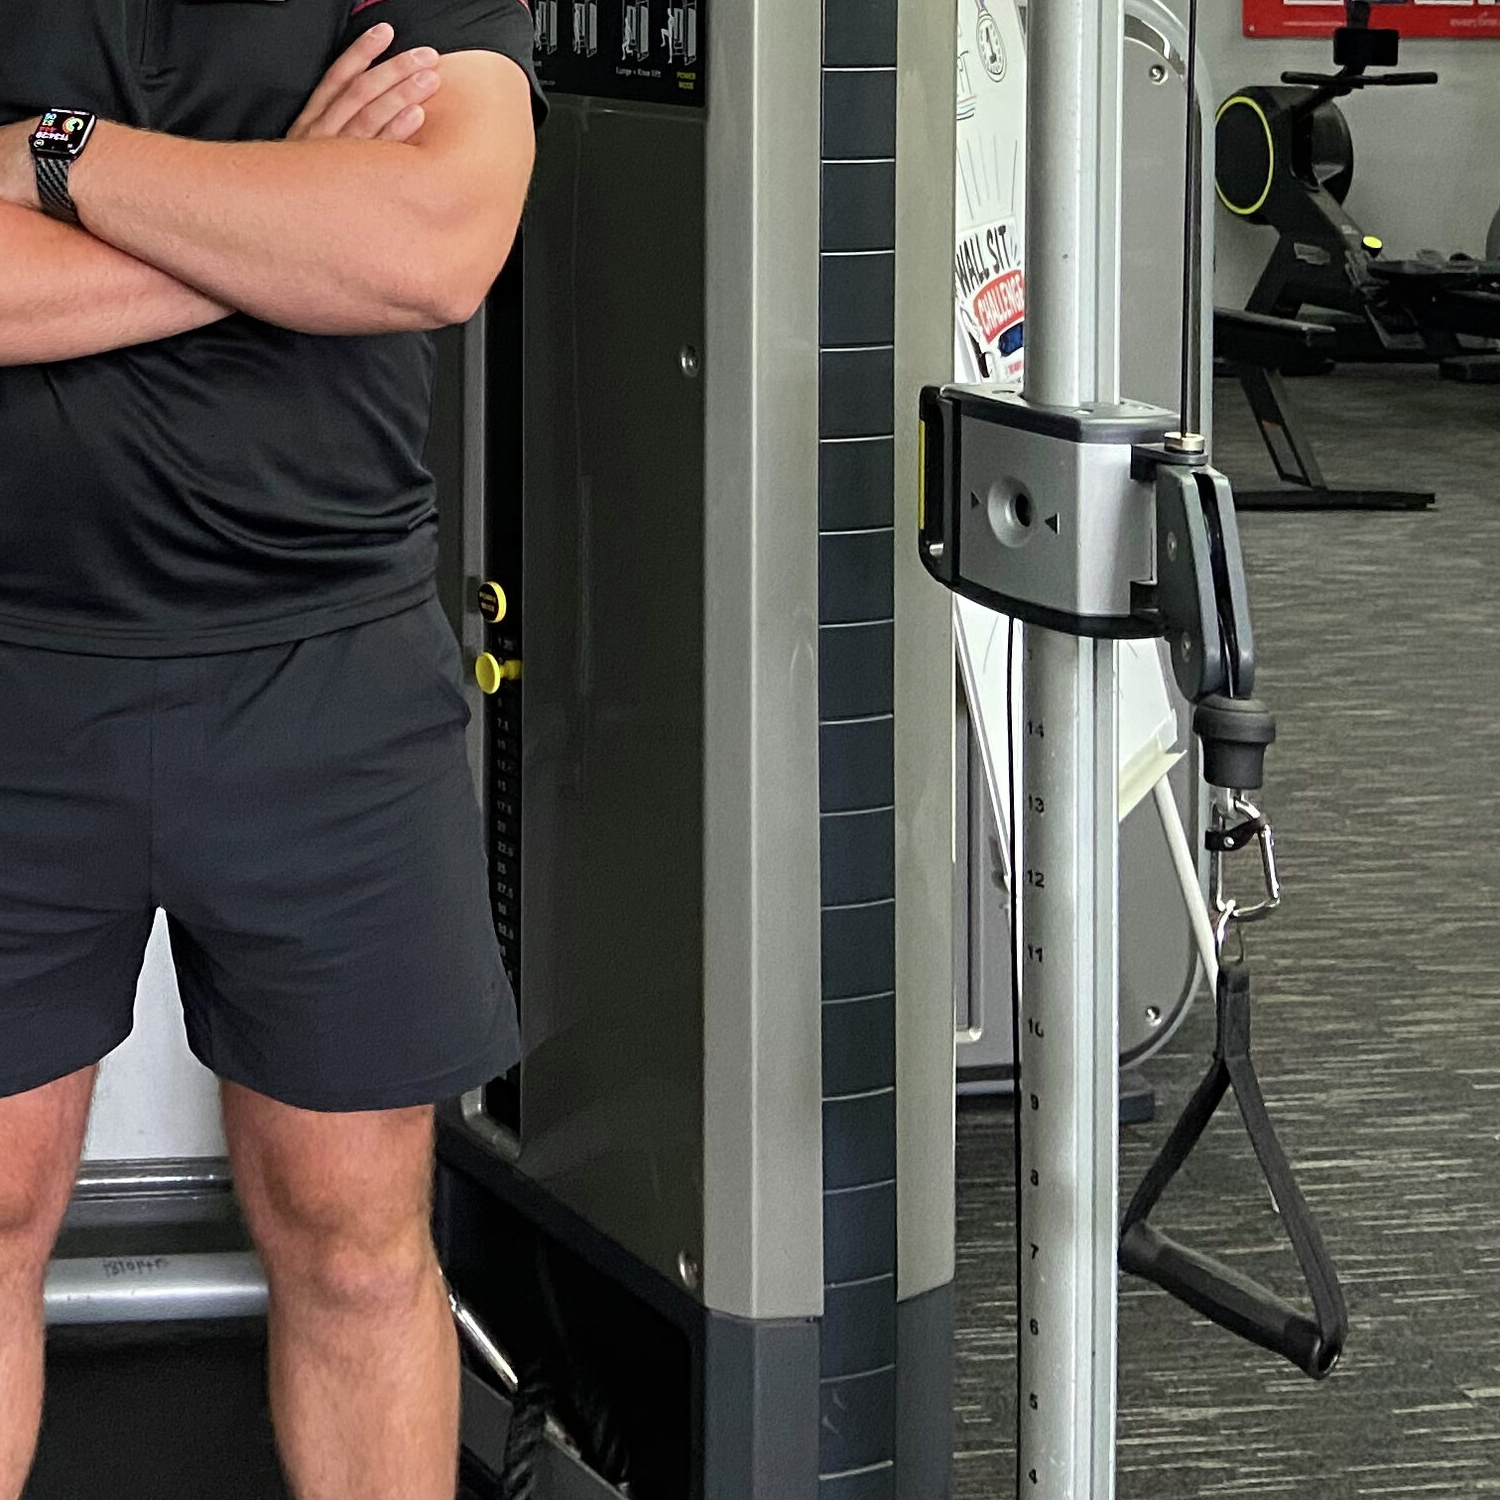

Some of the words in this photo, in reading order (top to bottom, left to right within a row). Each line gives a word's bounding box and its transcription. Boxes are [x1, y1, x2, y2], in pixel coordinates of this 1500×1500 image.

[955, 233, 990, 298] WALL
[986, 225, 1011, 275] SIT
[976, 273, 1025, 336] CHALLENGE
[1027, 721, 1044, 738] 14
[1028, 796, 1045, 813] 13
[1027, 870, 1045, 888] 12
[1027, 946, 1043, 962] 11
[1031, 1094, 1039, 1111] 9
[1031, 1169, 1039, 1186] 8
[1031, 1243, 1039, 1260] 7
[1030, 1318, 1039, 1336] 6
[1030, 1393, 1038, 1410] 5
[1029, 1468, 1038, 1485] 4
